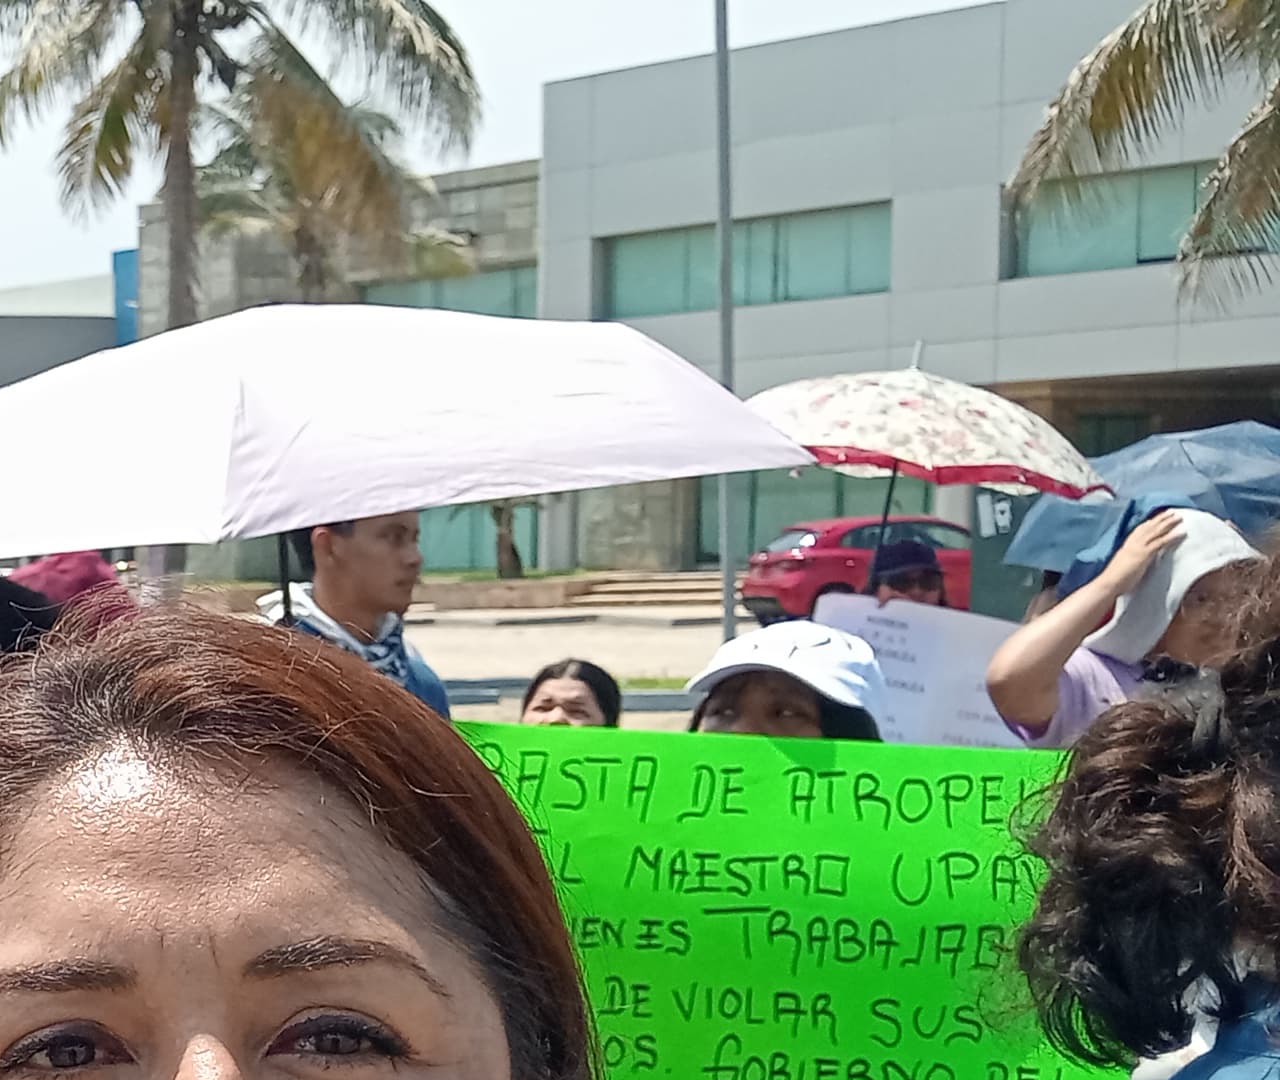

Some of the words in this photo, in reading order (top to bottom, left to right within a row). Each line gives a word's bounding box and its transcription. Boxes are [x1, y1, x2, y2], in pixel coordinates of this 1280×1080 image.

[675, 763, 748, 823] DE
[623, 844, 851, 898] MAESTRO
[598, 975, 653, 1019] DE
[670, 981, 838, 1046] VIOLAR
[868, 997, 984, 1049] SUS
